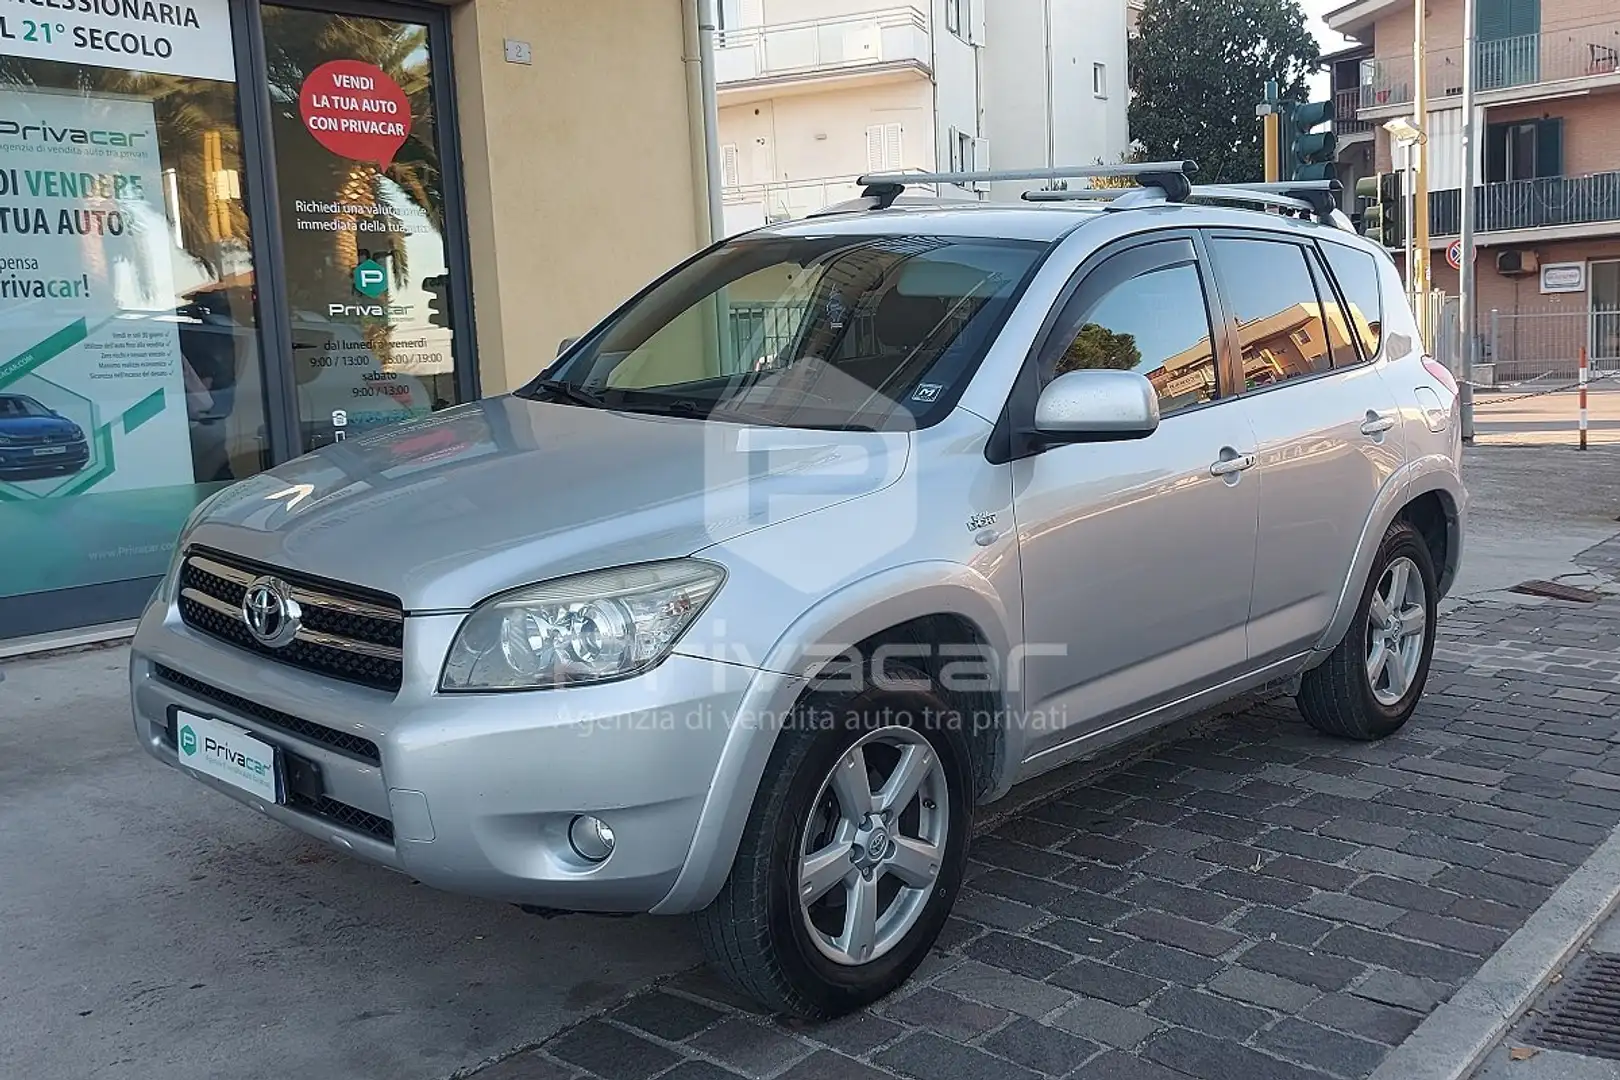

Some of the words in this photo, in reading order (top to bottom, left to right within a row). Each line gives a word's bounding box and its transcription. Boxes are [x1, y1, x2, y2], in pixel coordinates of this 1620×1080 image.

[73, 26, 173, 59] SECOLO
[332, 73, 374, 91] VENDI
[312, 94, 331, 109] LA
[331, 96, 359, 112] TUA
[362, 100, 397, 115] AUTO
[309, 116, 339, 131] CON
[341, 120, 405, 137] PRIVACAR
[0, 143, 34, 153] genzia
[24, 169, 144, 200] VENDERE
[295, 200, 341, 214] Richiedi
[342, 203, 365, 214] una
[0, 206, 51, 235] TUA
[297, 218, 358, 232] immediata
[360, 219, 386, 232] della
[360, 270, 383, 288] P
[328, 303, 414, 317] Privacar
[324, 339, 341, 351] dal
[310, 357, 332, 368] 9:00
[342, 355, 369, 367] 13:00
[362, 371, 397, 381] sabato
[352, 386, 375, 397] 9:00
[383, 384, 410, 396] 13:00
[182, 732, 195, 748] P
[204, 736, 271, 777] Privacar
